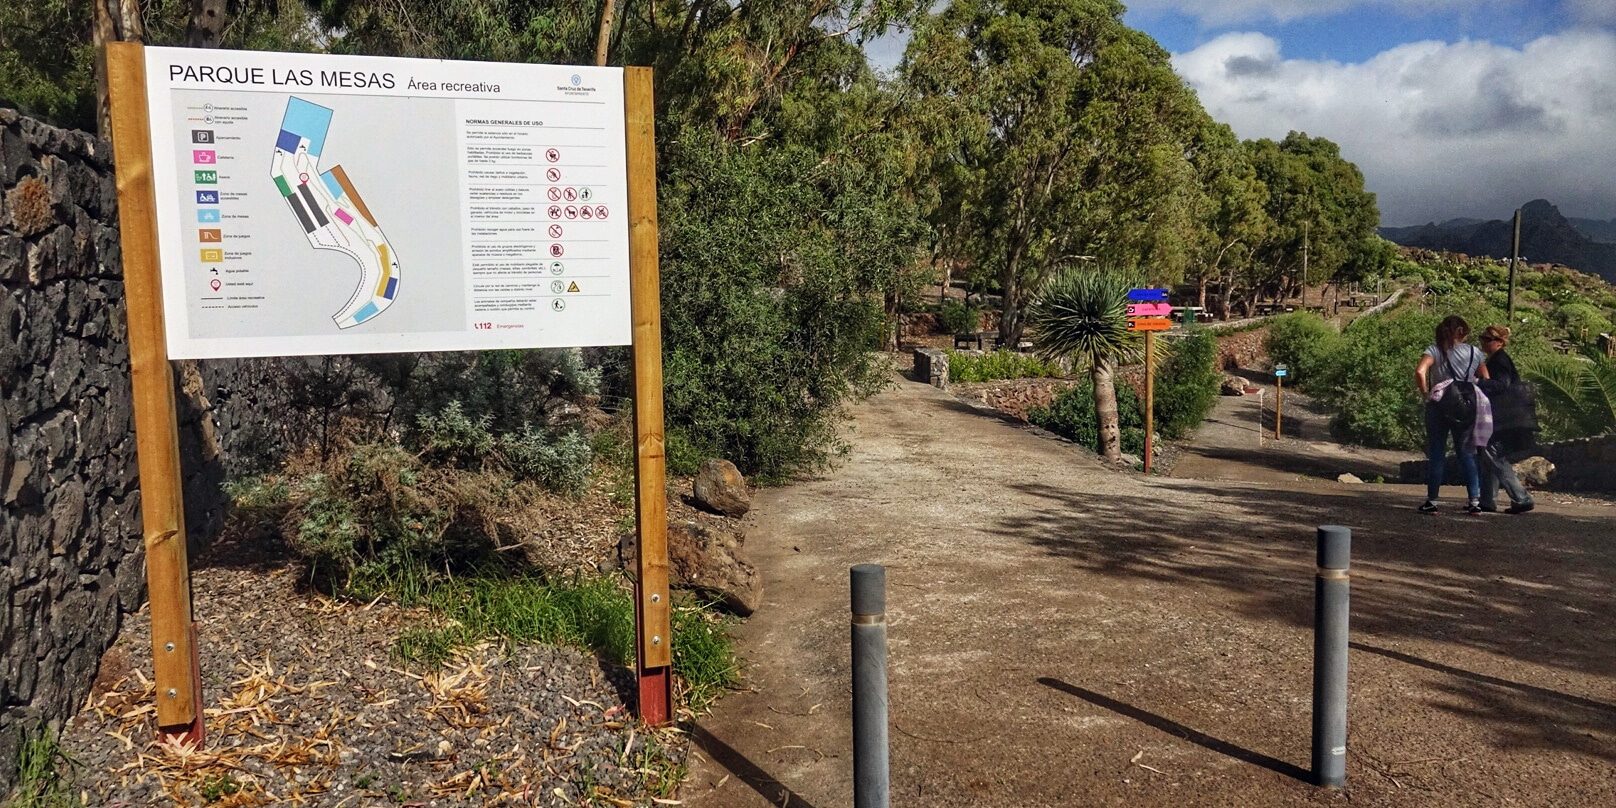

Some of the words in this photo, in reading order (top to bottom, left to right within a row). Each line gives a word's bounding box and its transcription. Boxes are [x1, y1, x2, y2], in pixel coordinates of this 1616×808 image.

[169, 64, 265, 84] PARQUE
[272, 68, 313, 87] LAS
[320, 70, 396, 89] MESAS
[407, 76, 437, 91] Área
[441, 81, 501, 93] recreativa
[479, 322, 492, 330] 112
